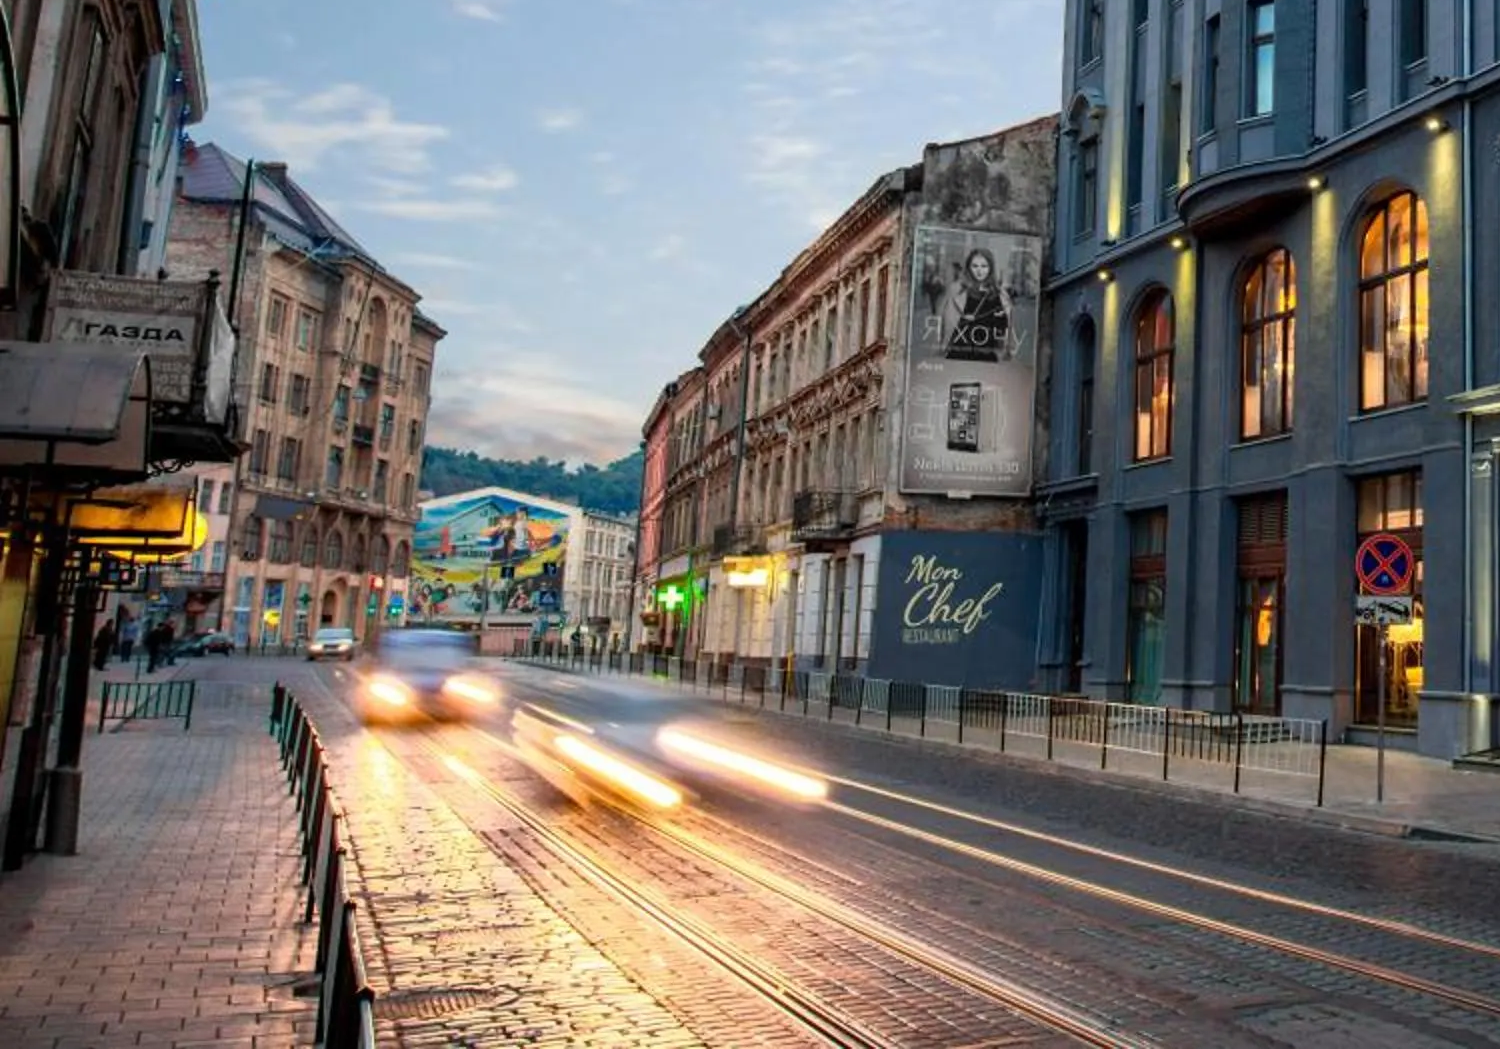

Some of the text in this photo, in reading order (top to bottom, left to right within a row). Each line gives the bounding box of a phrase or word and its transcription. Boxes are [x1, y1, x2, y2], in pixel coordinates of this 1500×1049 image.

[84, 323, 184, 342] ГАЗДА
[922, 315, 942, 343] Я
[904, 554, 963, 583] Mon
[903, 581, 1003, 634] Chef
